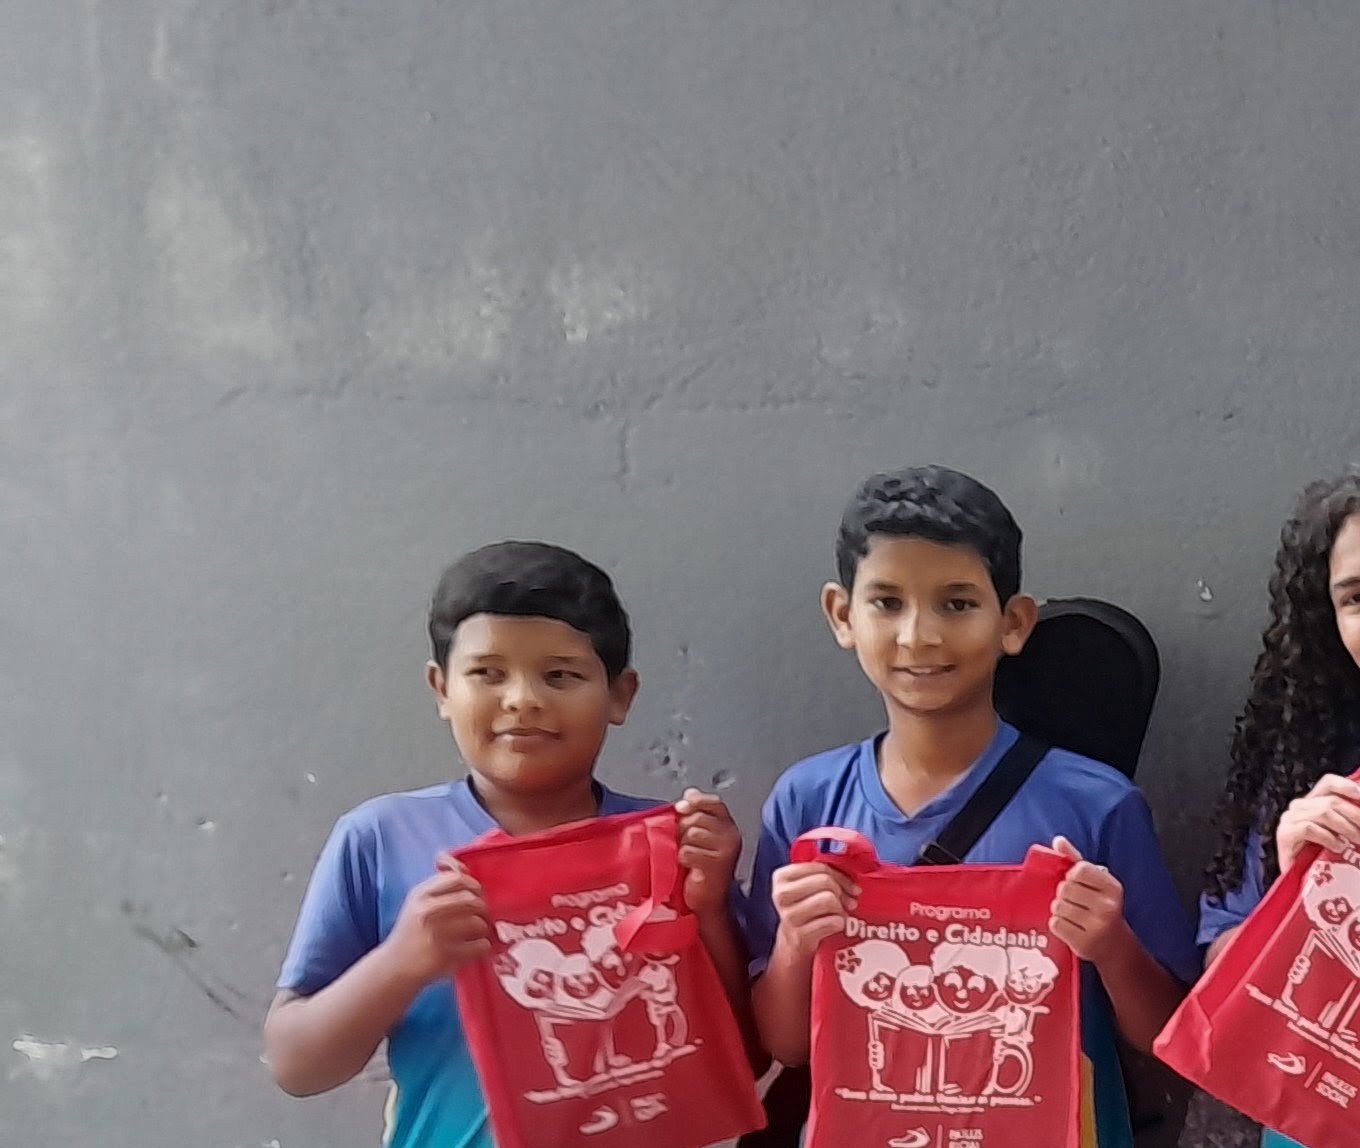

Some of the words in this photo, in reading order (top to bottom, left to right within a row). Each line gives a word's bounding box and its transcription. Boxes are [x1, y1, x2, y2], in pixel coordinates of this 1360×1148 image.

[910, 901, 991, 921] Programa
[845, 916, 921, 942] Direito
[925, 928, 940, 943] e
[944, 922, 1049, 949] Cidadania
